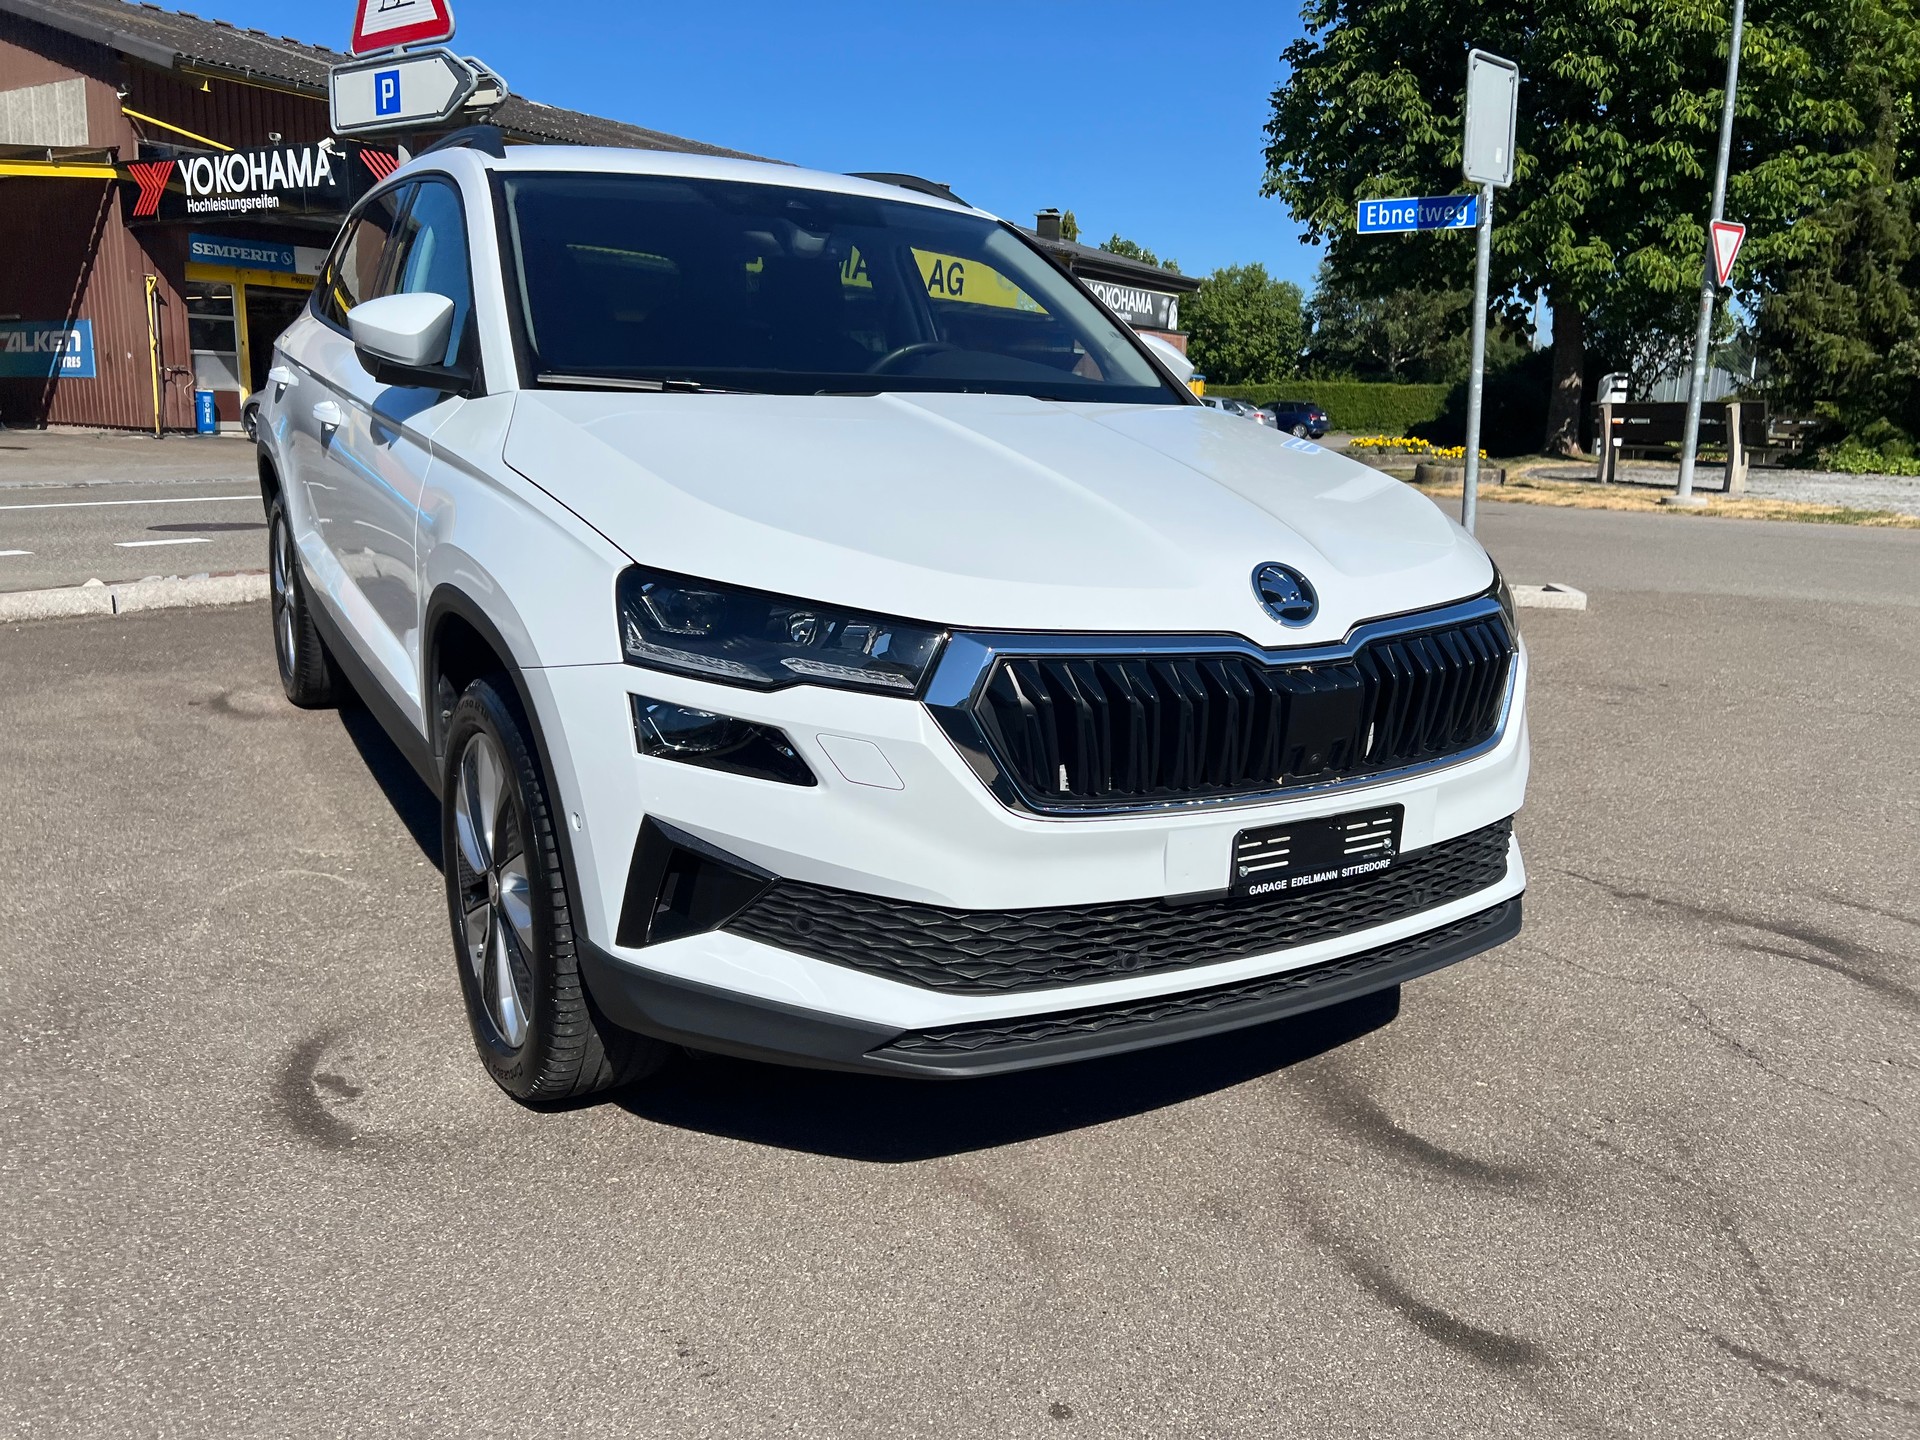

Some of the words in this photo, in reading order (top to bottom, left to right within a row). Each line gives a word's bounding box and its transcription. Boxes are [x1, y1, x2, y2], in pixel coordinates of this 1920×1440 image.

[381, 78, 395, 110] P
[178, 147, 335, 196] YOKOHAMA
[187, 195, 279, 213] Hochleistungsreifen
[1366, 204, 1468, 226] Ebnetweg
[192, 241, 278, 263] SEMPERIT
[928, 259, 965, 297] AG
[57, 356, 81, 368] TYRES
[1249, 880, 1288, 895] GARAGE
[1291, 870, 1338, 888] EDELMANN
[1341, 858, 1391, 878] SITTERDORF
